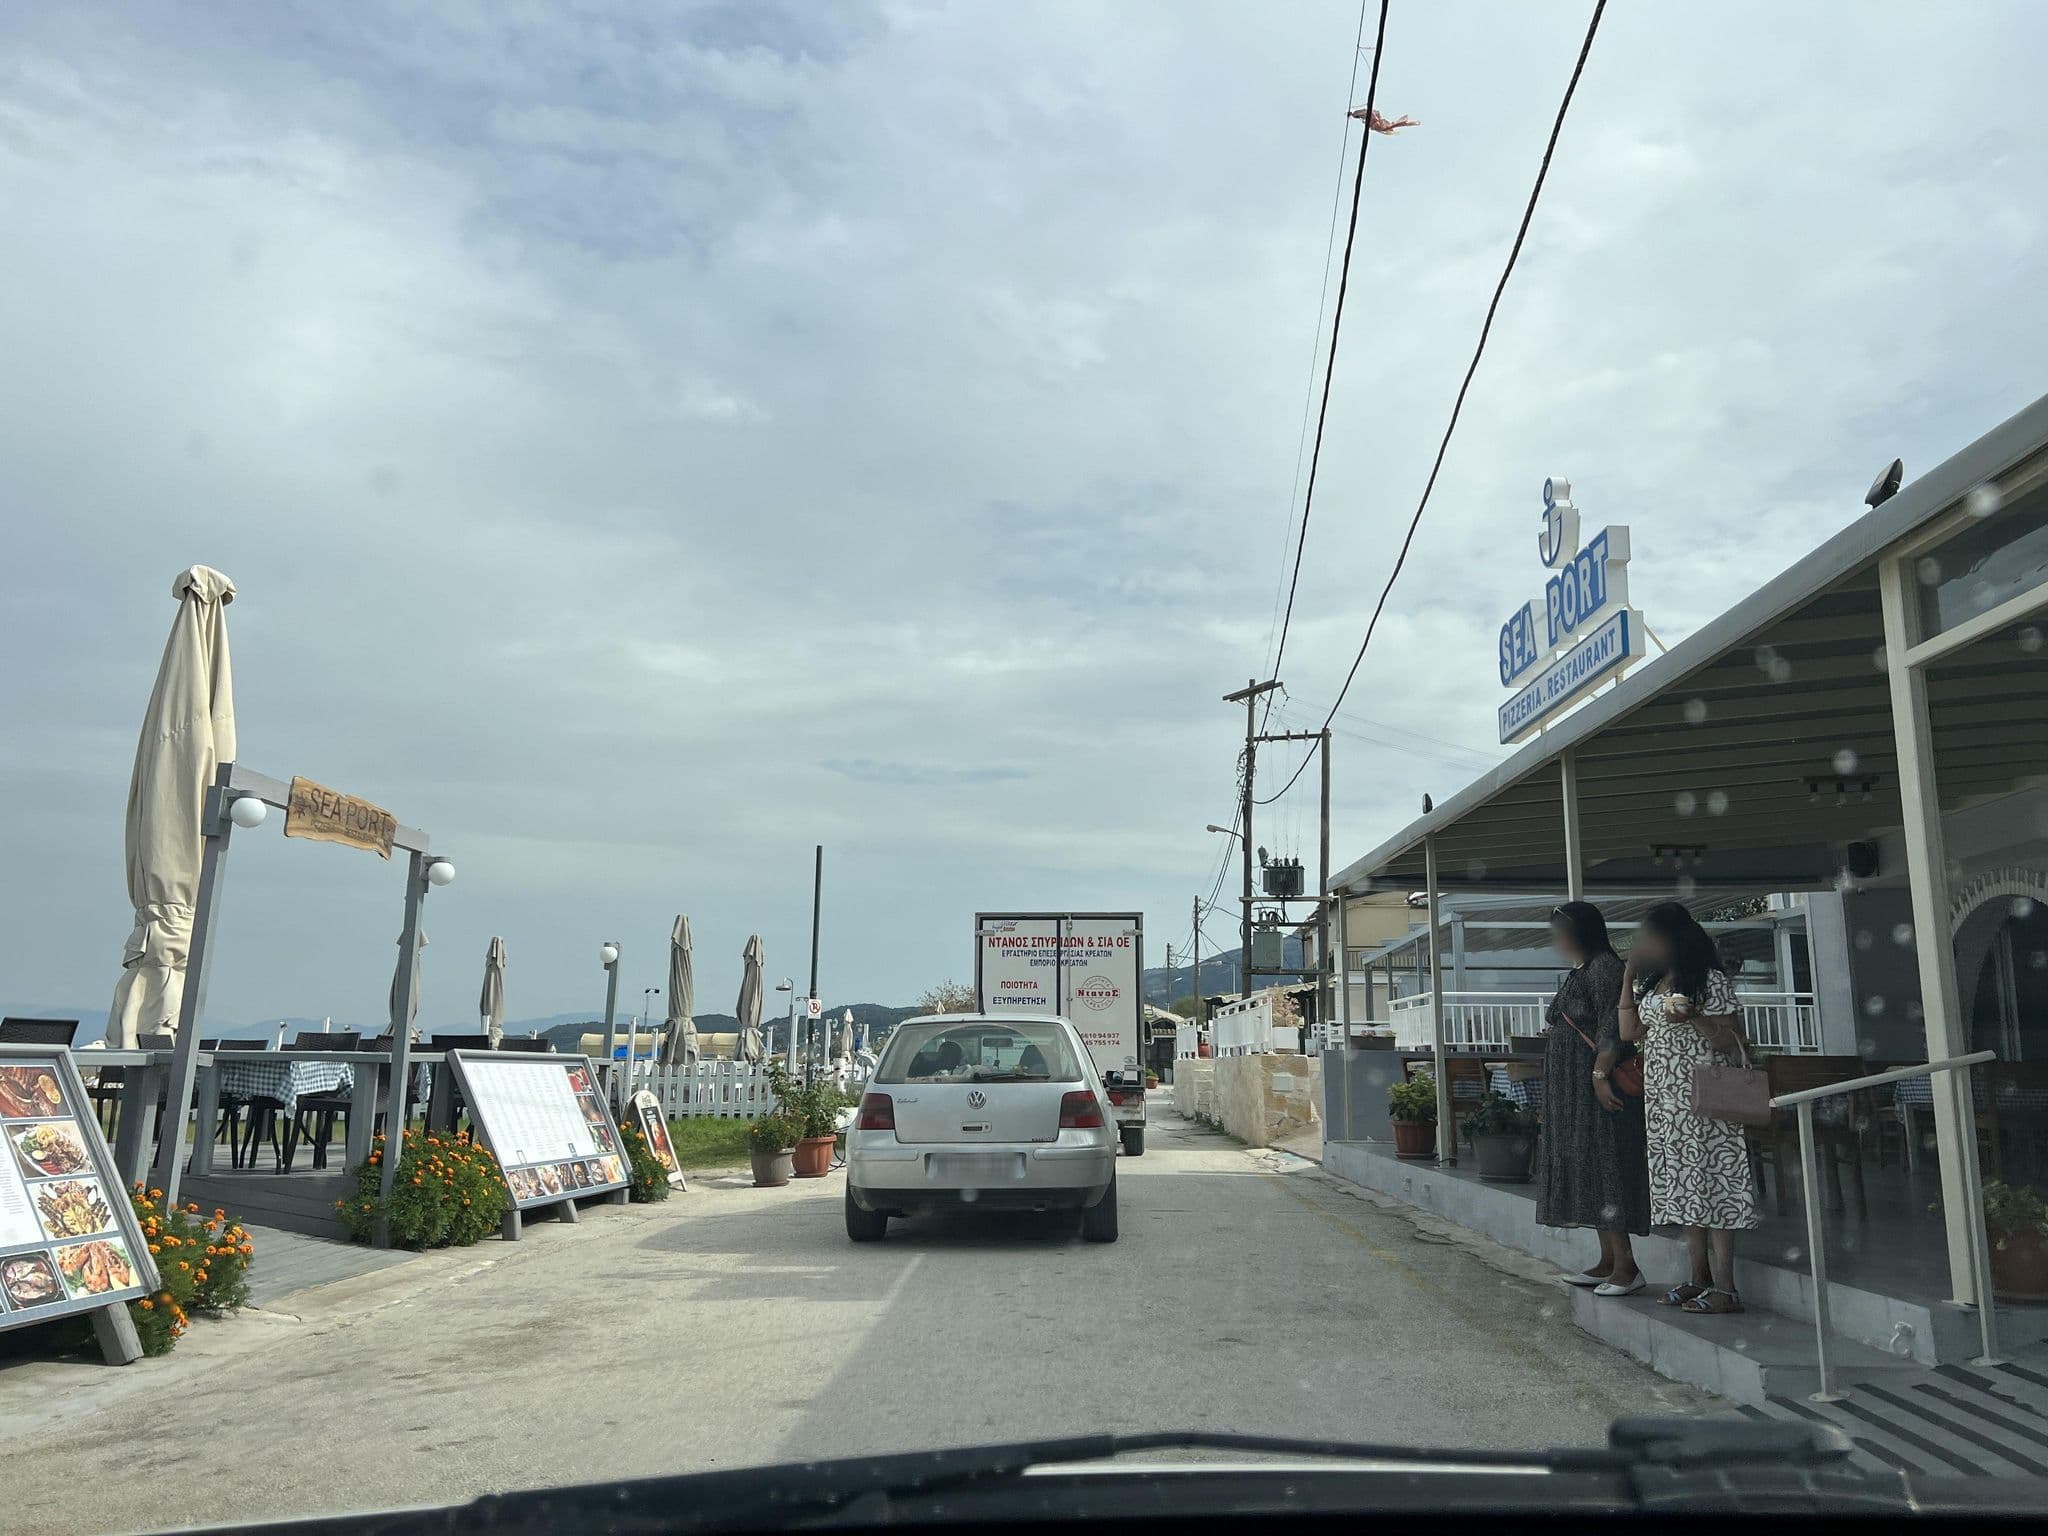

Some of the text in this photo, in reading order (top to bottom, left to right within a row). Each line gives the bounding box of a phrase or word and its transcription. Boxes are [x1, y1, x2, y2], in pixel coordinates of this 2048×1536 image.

[1500, 532, 1608, 687] SEA PORT
[1548, 628, 1616, 699] RESTAURANT
[311, 788, 342, 822] SEA
[346, 801, 391, 837] PORT
[988, 936, 1029, 948] ΝΤΑΝΟΣ
[1087, 936, 1094, 948] &
[1098, 936, 1114, 948] ΣΙΑ
[1116, 936, 1130, 948] ΟΕ
[1001, 981, 1038, 990] ΠΟΙΟΤΗΤΑ
[993, 996, 1047, 1006] ΕΞΥΠΗΡΕΤΗΣΗ
